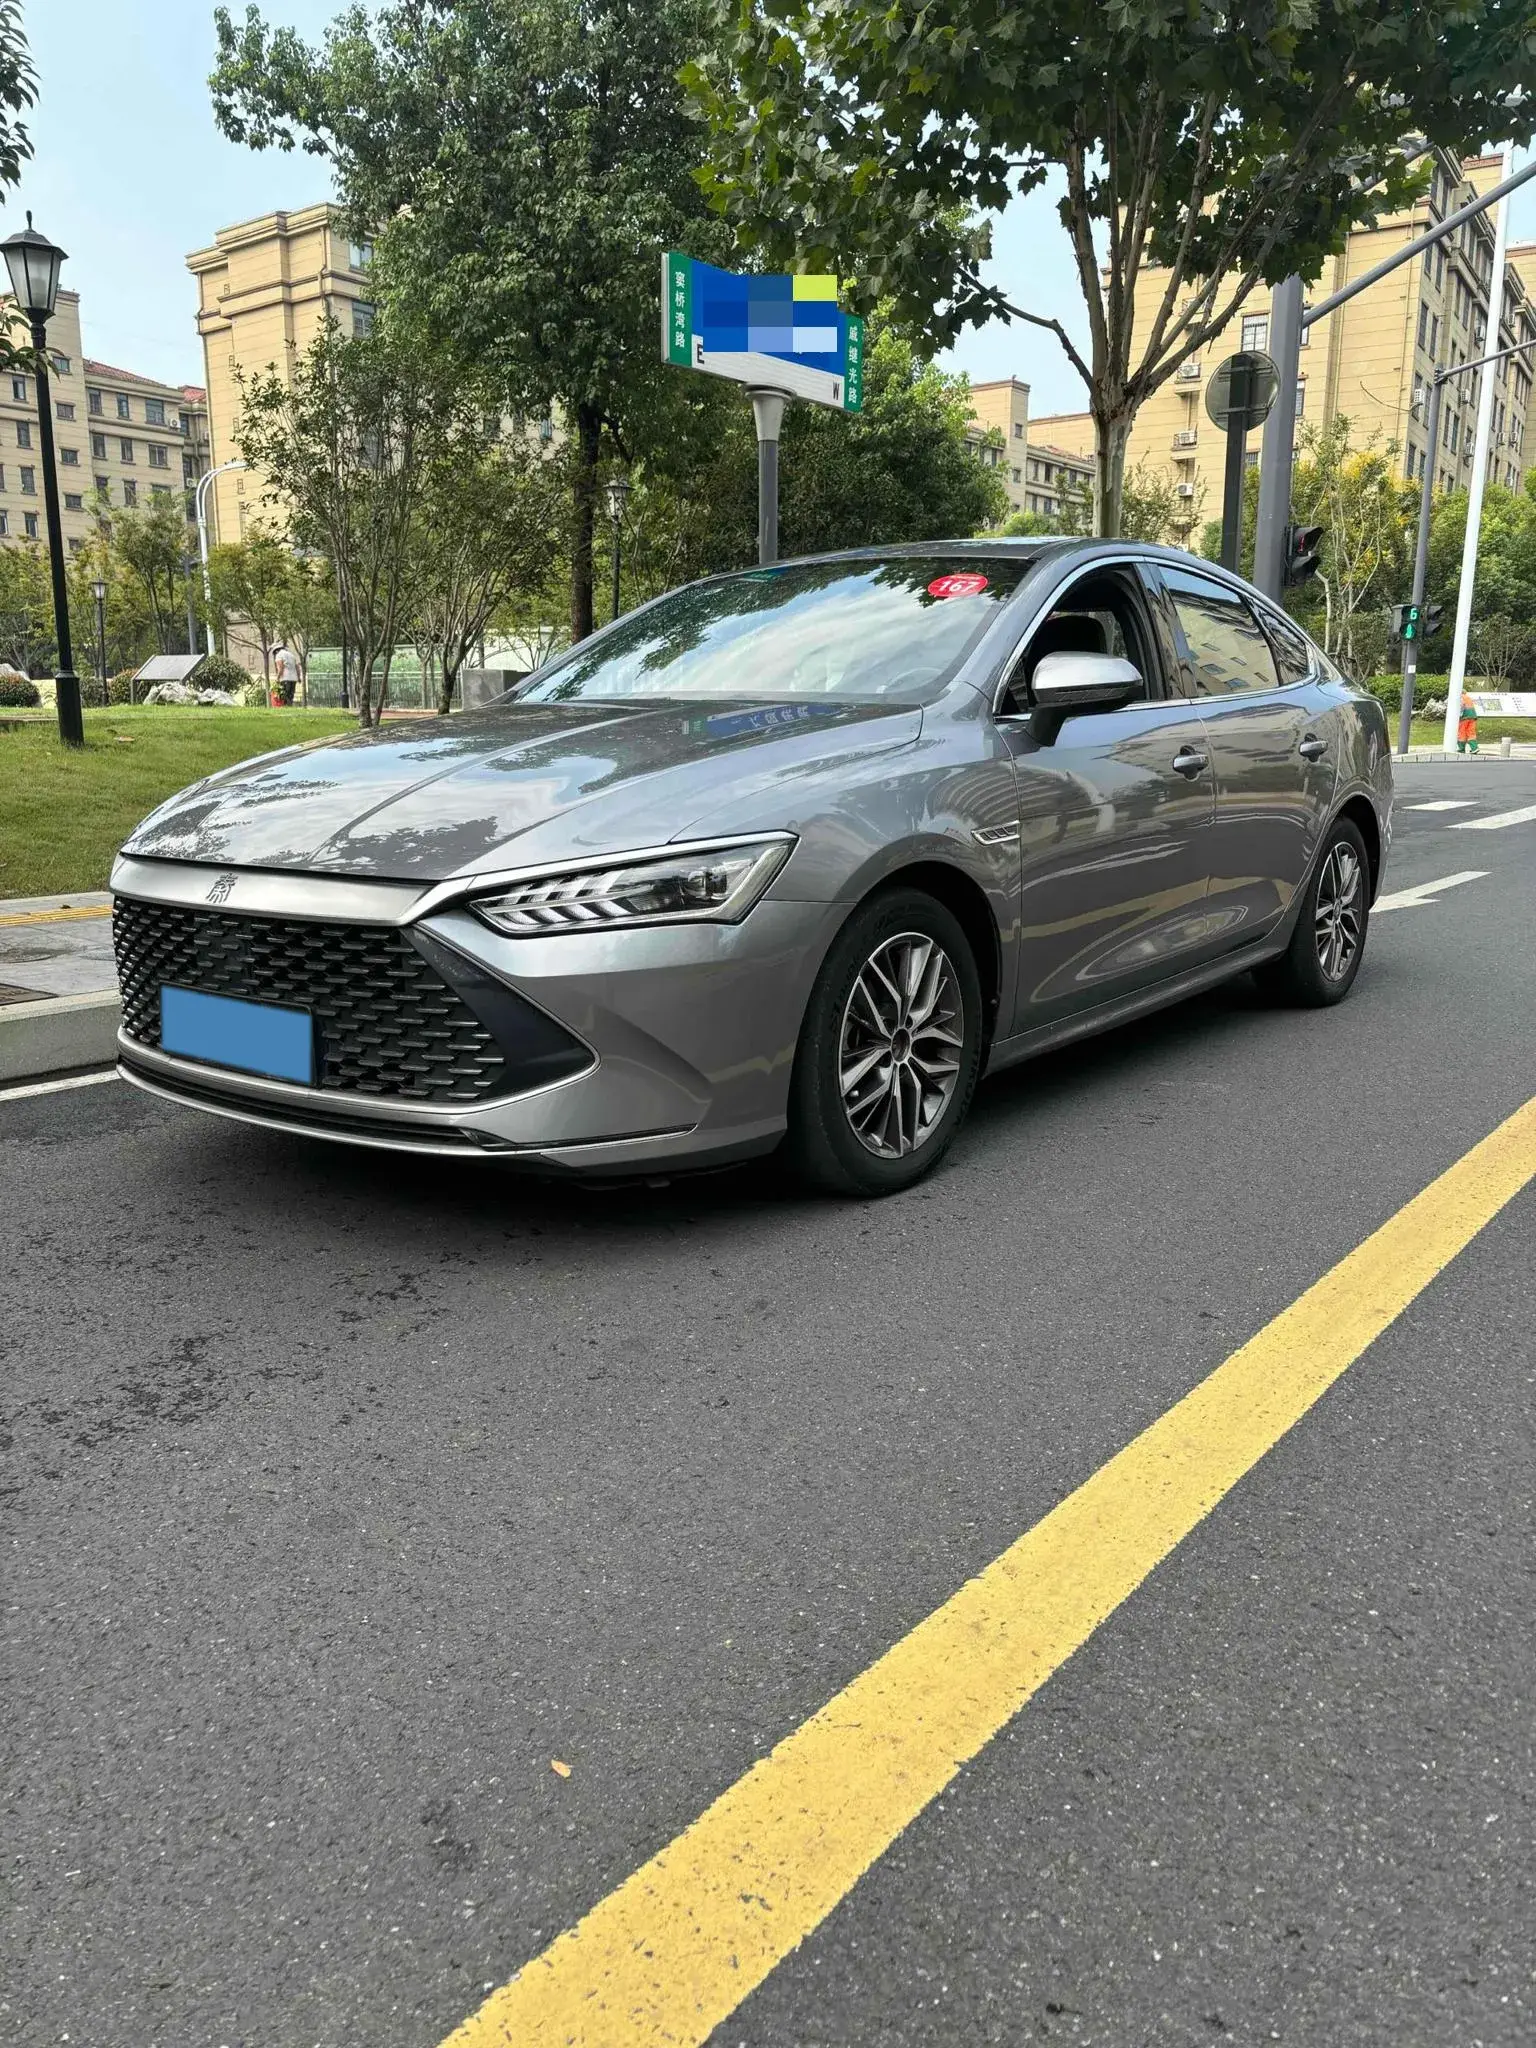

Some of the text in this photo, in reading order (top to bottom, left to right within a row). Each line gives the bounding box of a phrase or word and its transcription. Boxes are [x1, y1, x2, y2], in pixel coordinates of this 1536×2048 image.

[697, 344, 704, 364] E
[833, 381, 840, 400] W
[939, 580, 980, 592] 167
[1410, 607, 1418, 620] 6
